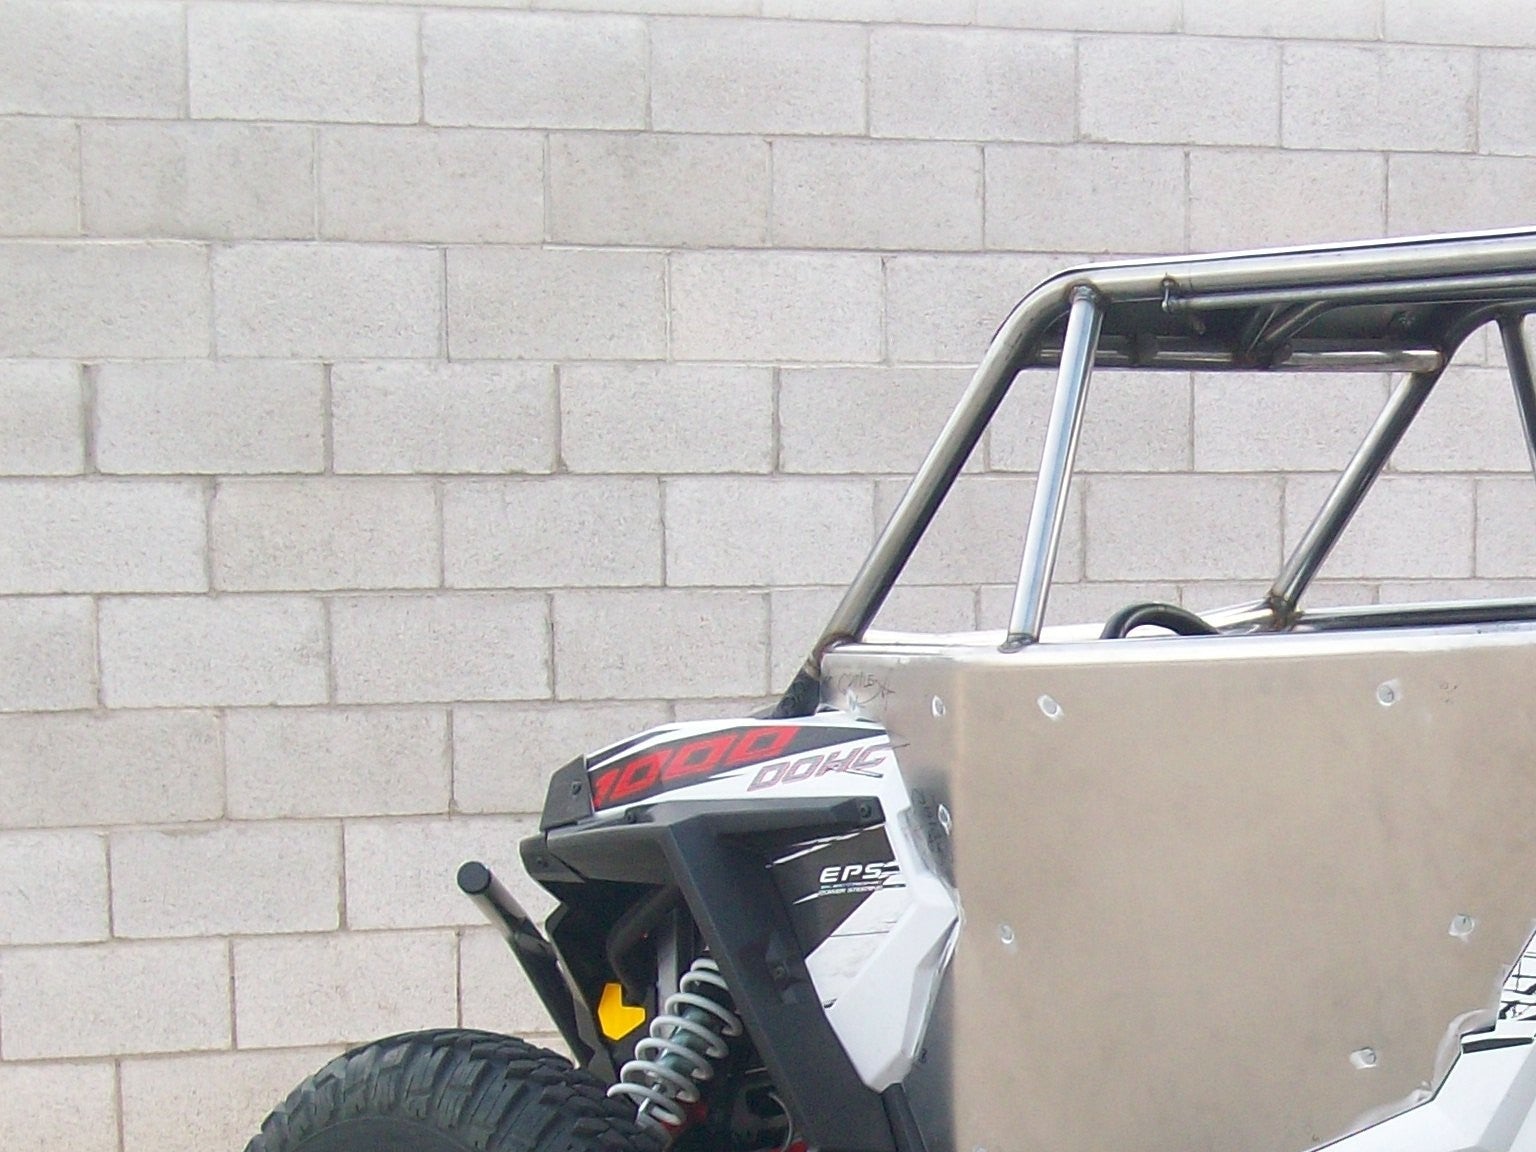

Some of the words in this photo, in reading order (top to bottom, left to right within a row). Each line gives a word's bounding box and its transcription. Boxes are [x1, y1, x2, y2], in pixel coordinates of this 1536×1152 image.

[592, 726, 799, 808] 1000
[747, 744, 890, 791] DOHC
[820, 863, 884, 882] EPS
